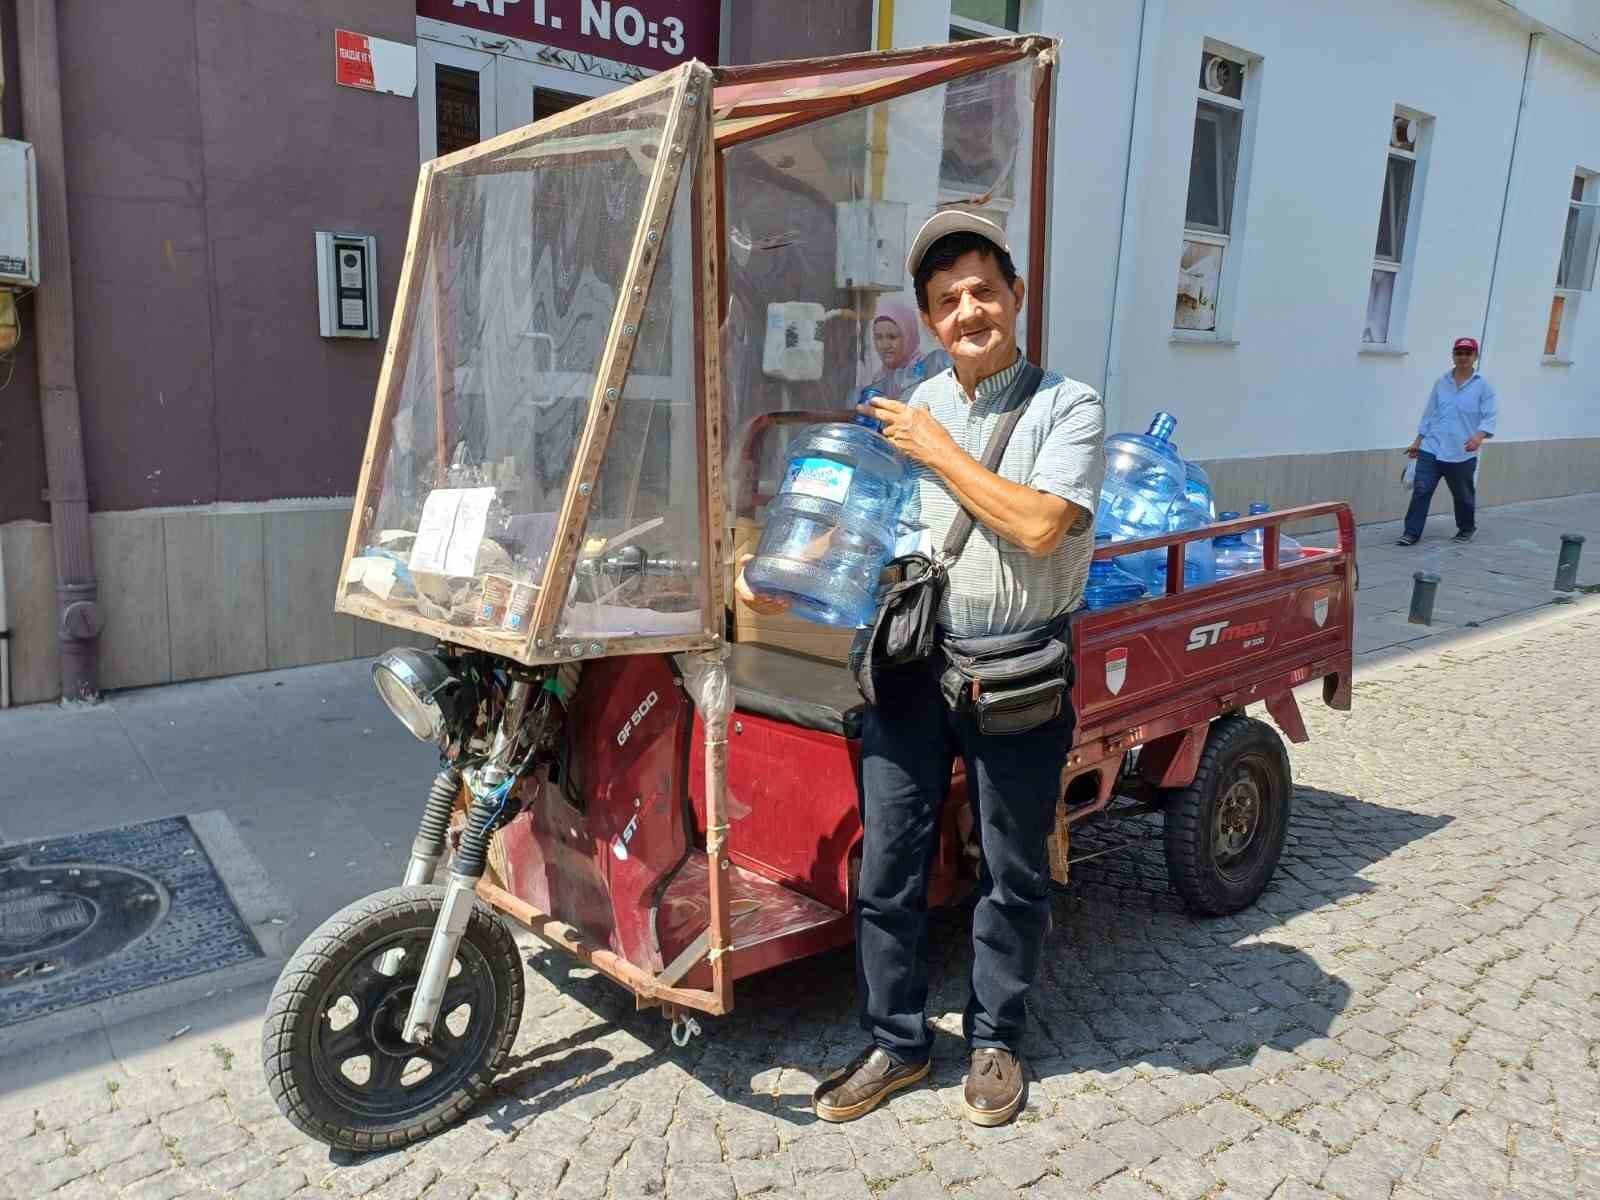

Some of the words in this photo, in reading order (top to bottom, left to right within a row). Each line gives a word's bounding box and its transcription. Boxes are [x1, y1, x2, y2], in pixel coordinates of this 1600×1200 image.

[452, 0, 562, 29] T.
[581, 0, 685, 55] NO:3
[617, 721, 631, 746] GF
[631, 691, 658, 726] 500
